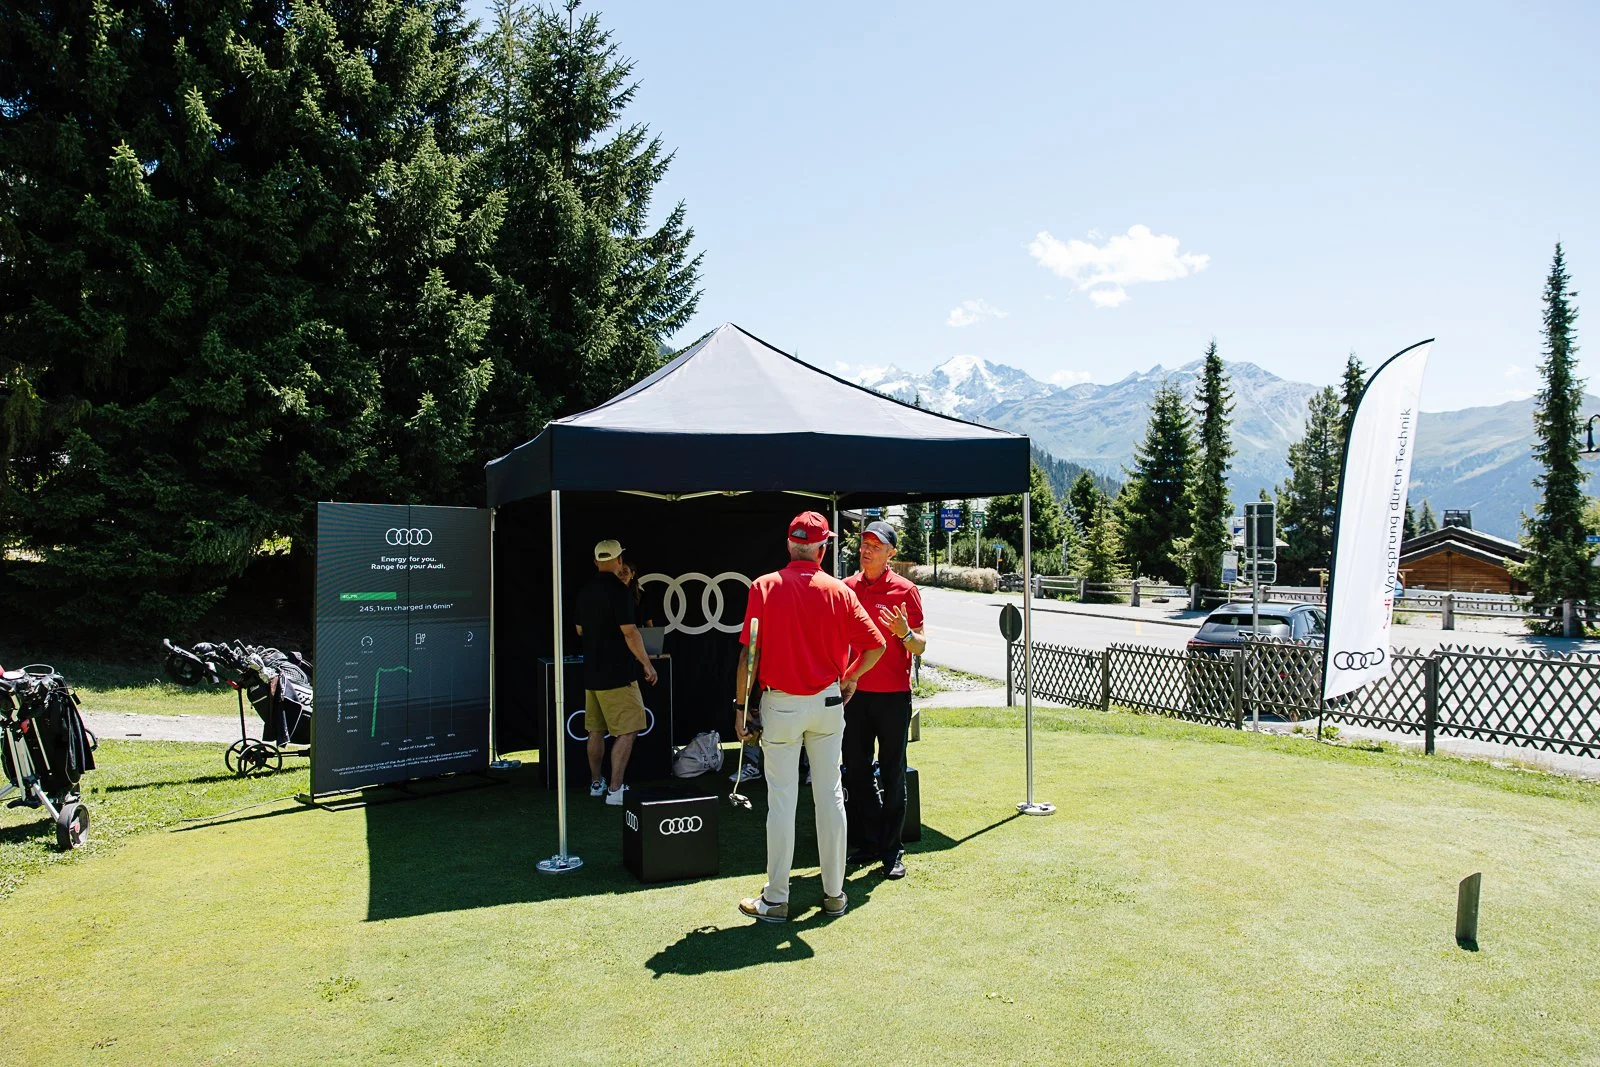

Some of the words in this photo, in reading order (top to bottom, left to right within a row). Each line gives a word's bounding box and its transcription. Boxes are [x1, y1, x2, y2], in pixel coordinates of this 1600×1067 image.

[1394, 407, 1412, 463] Technik
[1390, 469, 1402, 511] durch
[371, 563, 395, 571] Range
[381, 556, 407, 564] Energy
[1384, 515, 1400, 594] Vorsprung
[393, 603, 424, 612] charged
